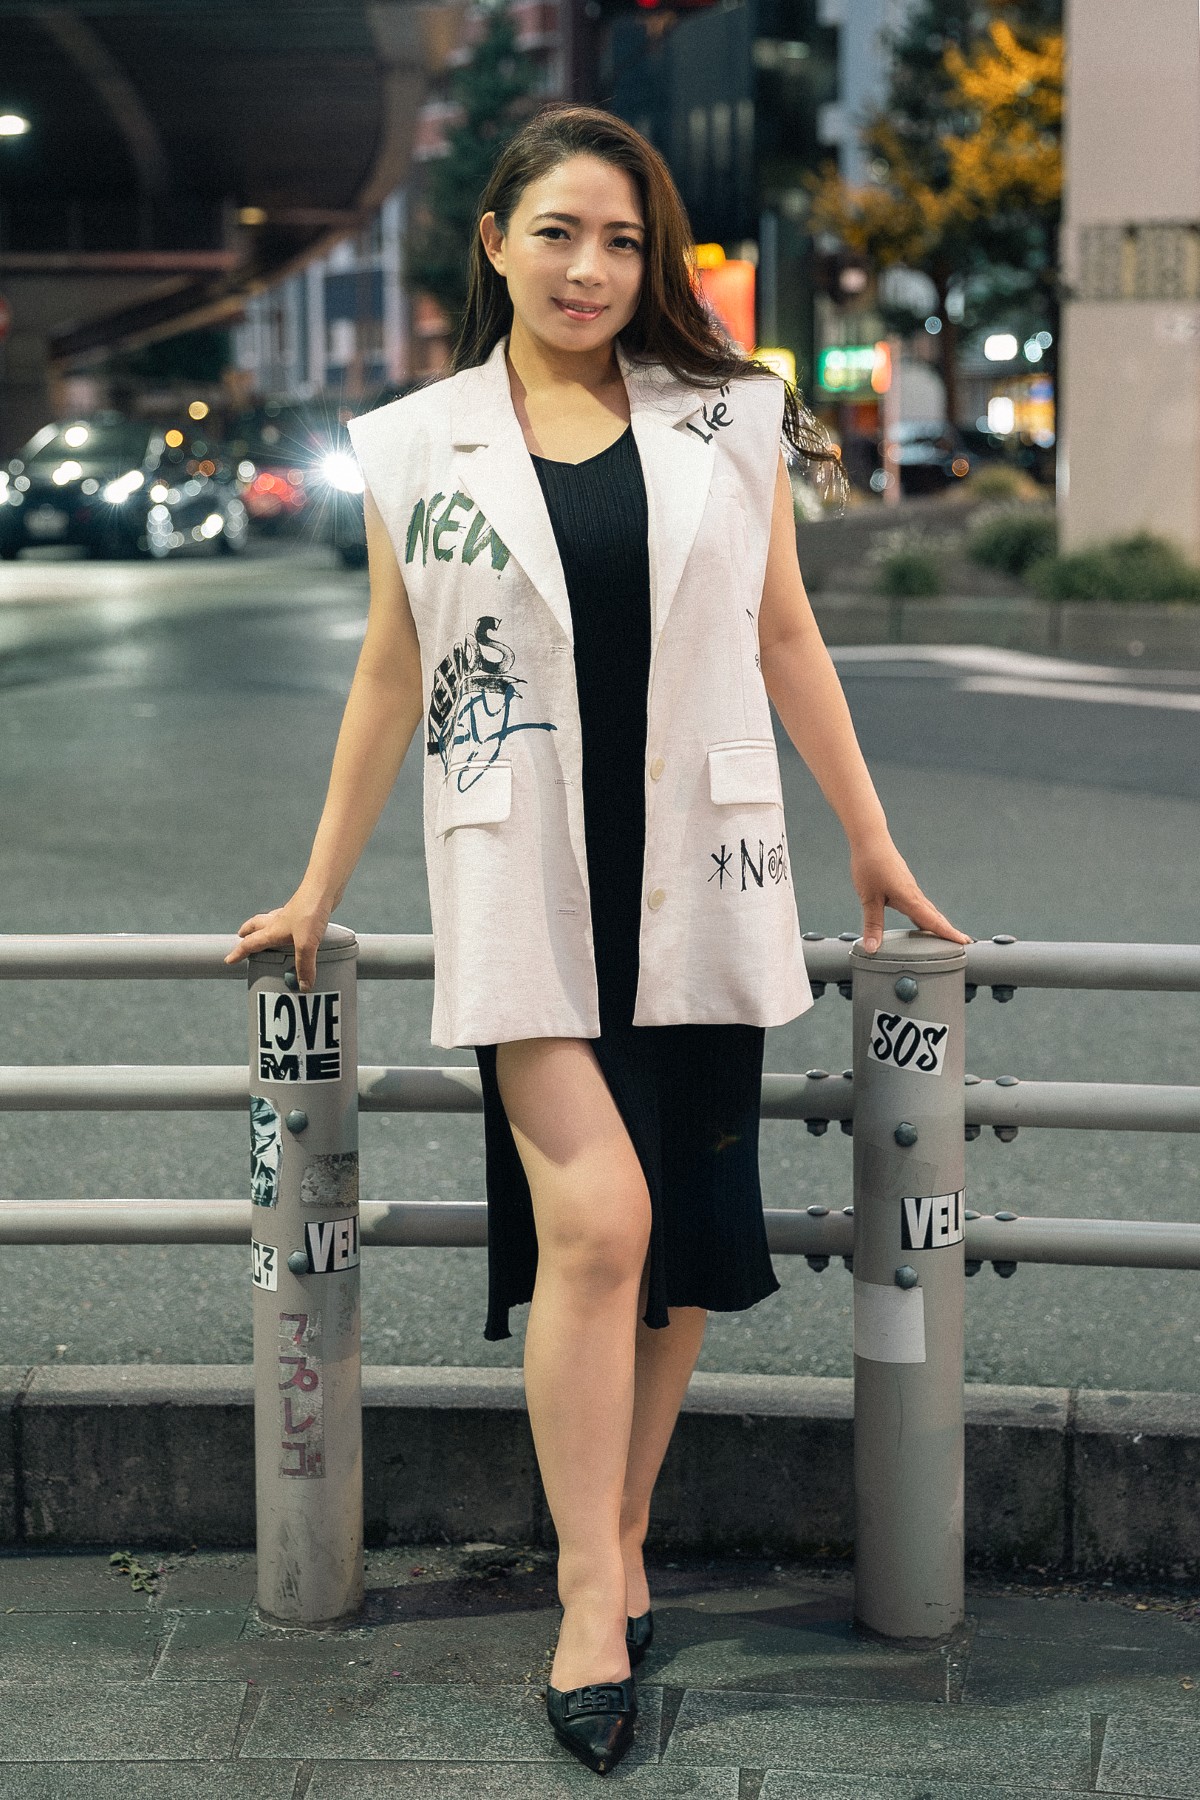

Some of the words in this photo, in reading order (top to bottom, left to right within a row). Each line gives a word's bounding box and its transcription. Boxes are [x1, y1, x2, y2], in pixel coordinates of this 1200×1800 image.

[258, 993, 340, 1050] LOVE
[873, 1012, 947, 1072] SOS
[260, 1052, 341, 1081] ME
[307, 1215, 361, 1273] VEL
[904, 1187, 966, 1249] VEL
